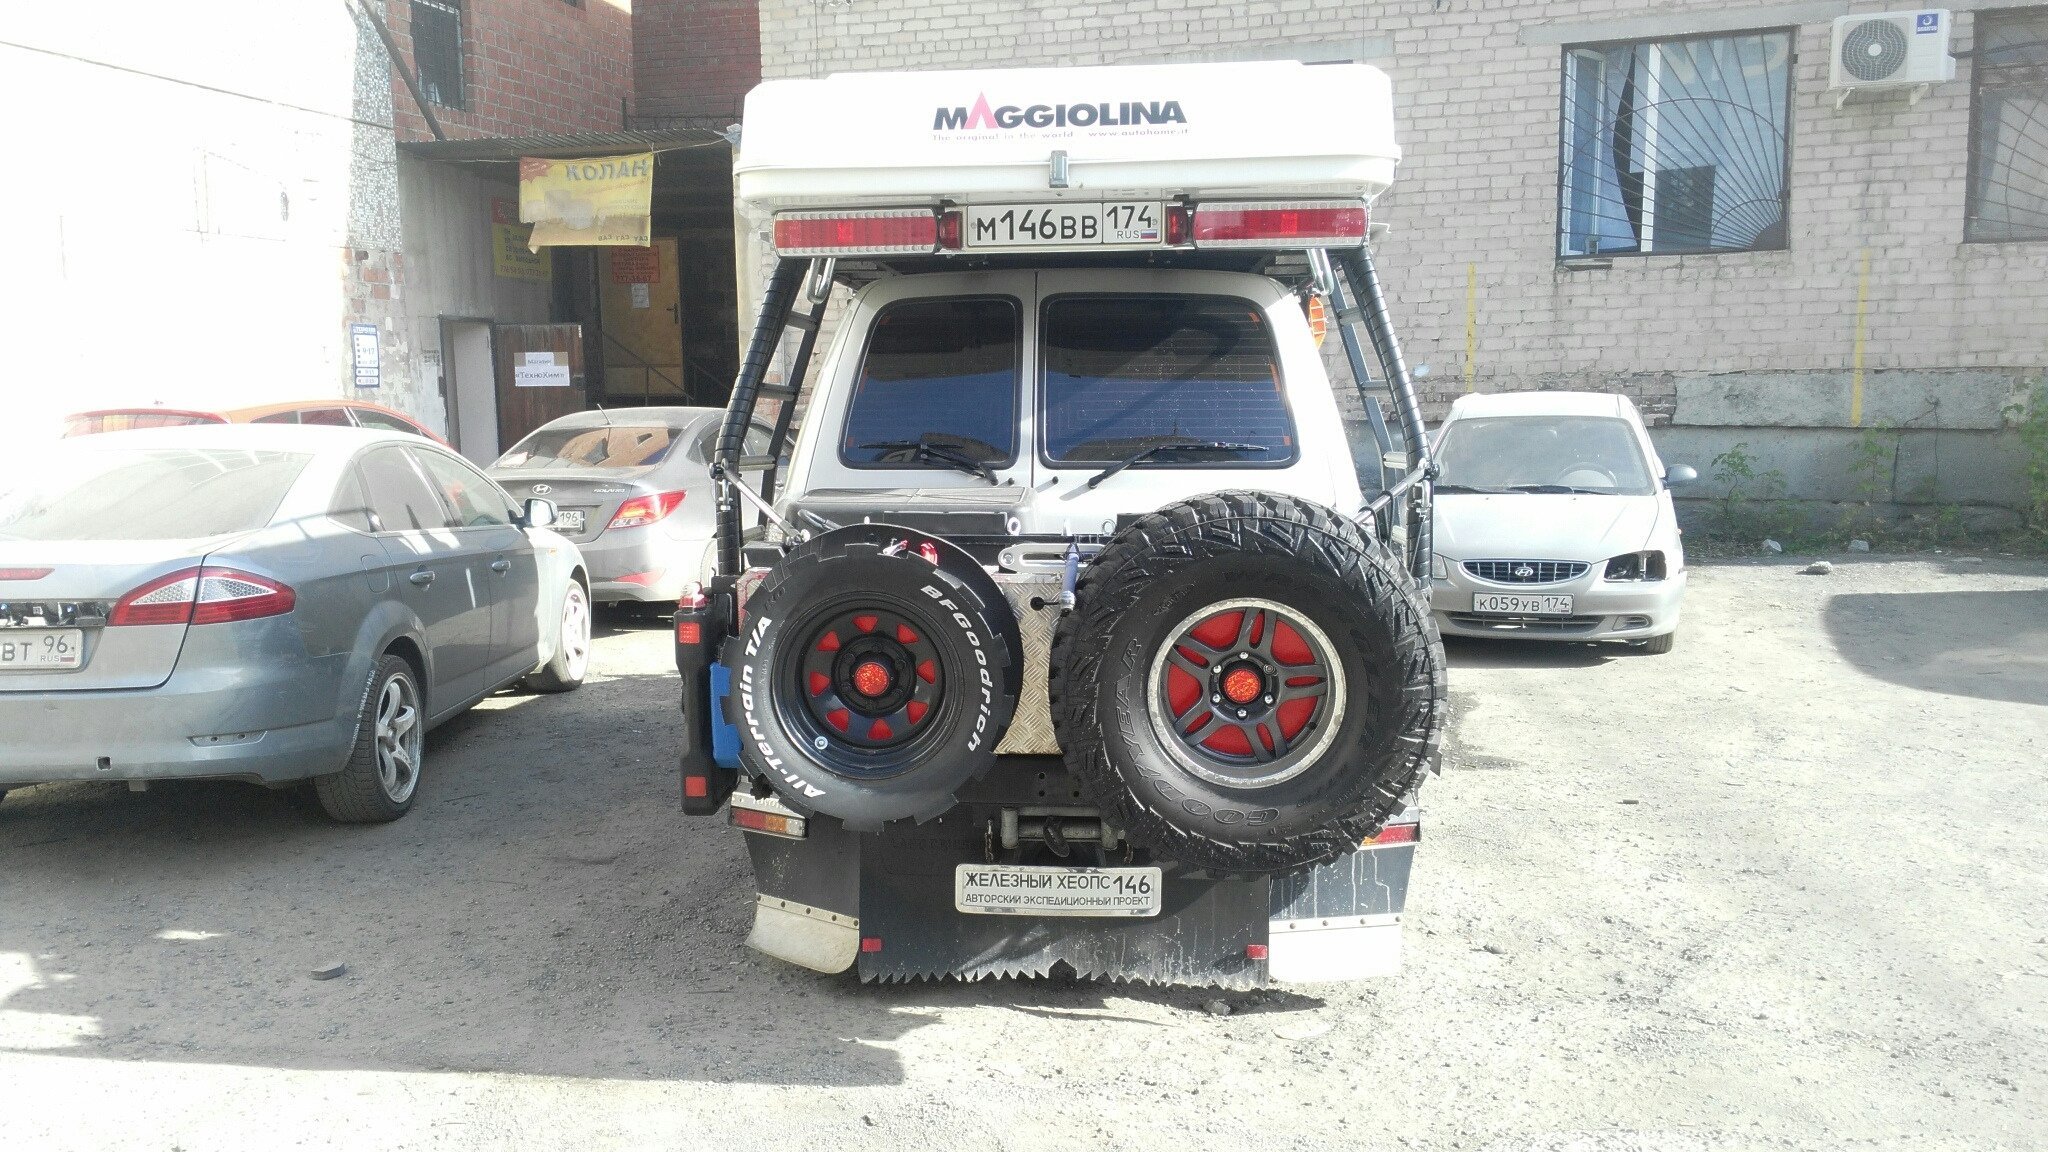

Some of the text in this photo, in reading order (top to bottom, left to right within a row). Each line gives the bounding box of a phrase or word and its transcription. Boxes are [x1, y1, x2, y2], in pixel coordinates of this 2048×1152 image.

[933, 91, 1188, 131] MAGGIOLINA
[1042, 131, 1073, 139] world
[1088, 128, 1189, 137] www.autohome.it
[1106, 205, 1152, 230] 174
[1116, 230, 1140, 239] RUS
[1544, 597, 1569, 608] 174
[43, 635, 69, 654] 96
[744, 616, 773, 657] T/A
[921, 585, 994, 752] BFGoodrich
[740, 663, 827, 799] All-Terrain
[1114, 638, 1281, 827] GOODYEAR
[965, 872, 1151, 895] ЖЕЛЕЗНЫЙ ХЕОПС 146
[965, 894, 1022, 904] АВТОРСКИЙ
[1113, 896, 1151, 906] ПРОЕКТ
